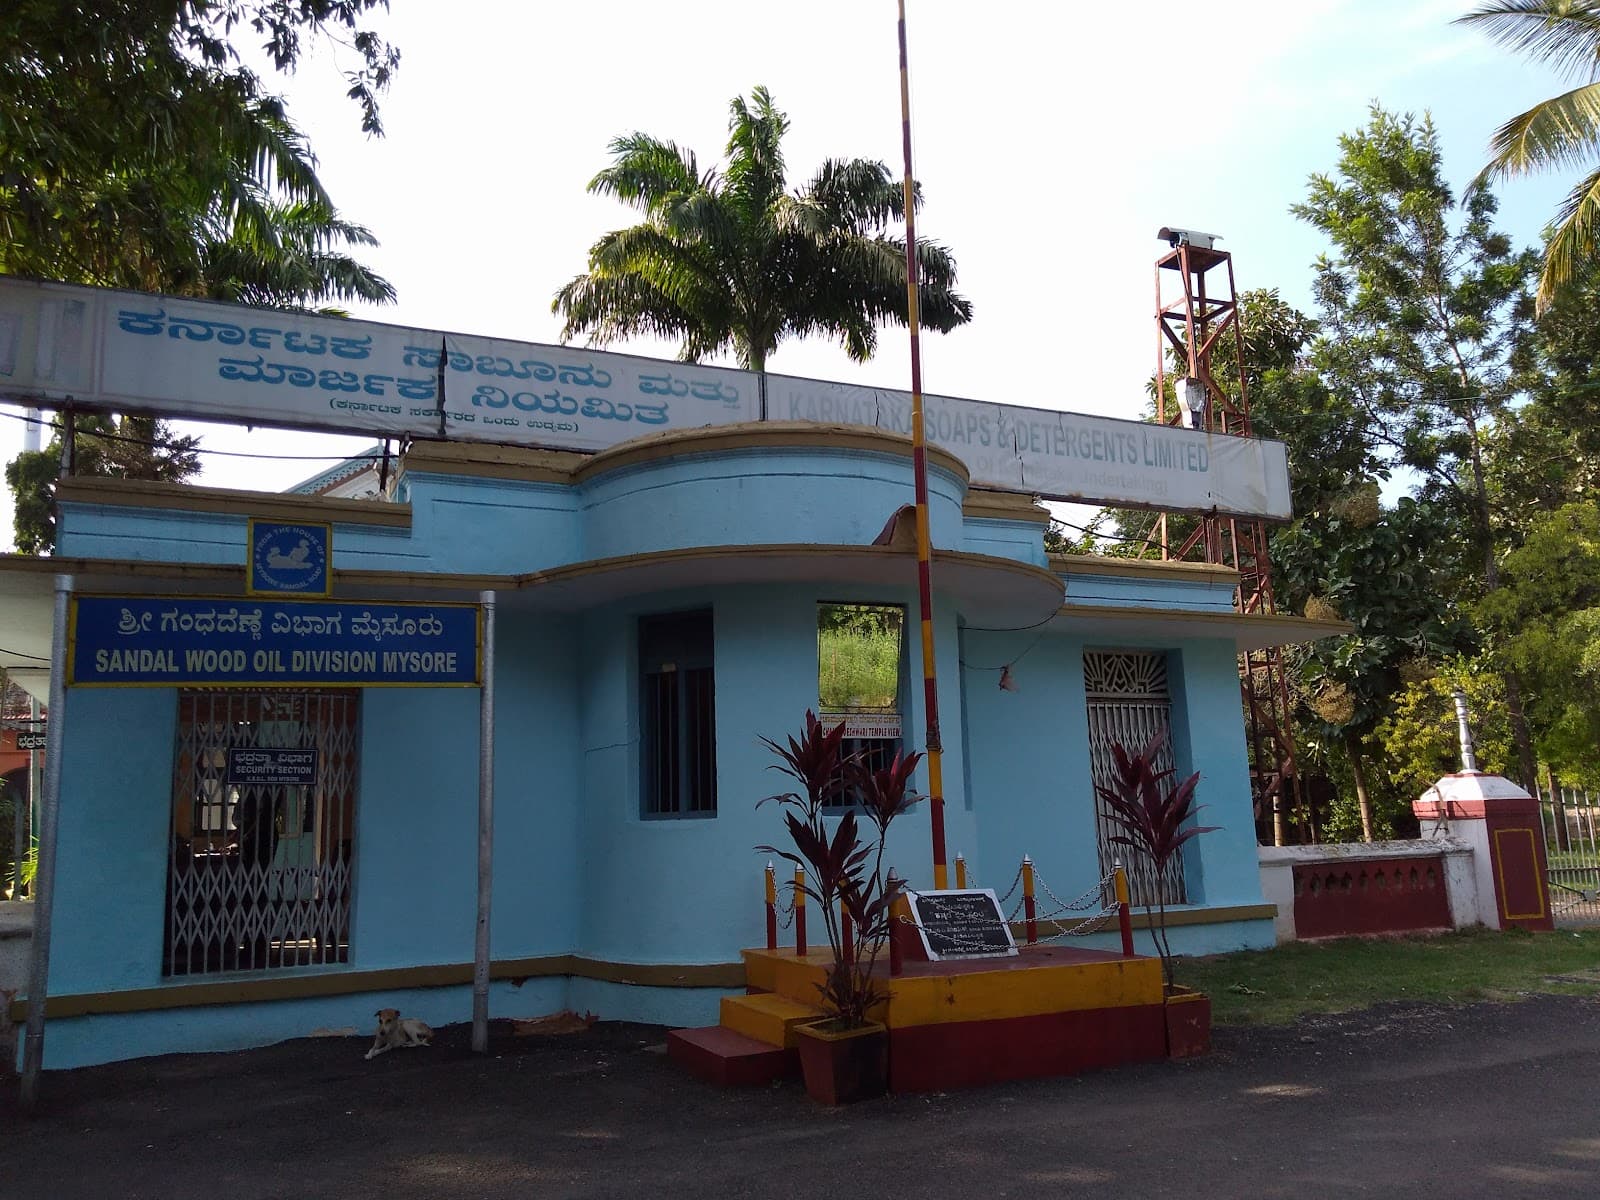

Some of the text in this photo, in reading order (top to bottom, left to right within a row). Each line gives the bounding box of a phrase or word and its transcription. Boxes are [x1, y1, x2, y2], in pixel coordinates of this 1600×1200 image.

[118, 308, 372, 360] ಕರ್ನಾಟಕ
[402, 345, 612, 388] ಸಾಬೂನು
[219, 355, 670, 425] ಮಾರ್ಜಕ ನಿಯಮಿತ
[329, 398, 402, 415] (ಕರ್ನಾಟಕ
[483, 416, 520, 427] ಒಂದು
[926, 407, 991, 447] SOAPS
[996, 413, 1012, 448] &
[1014, 420, 1137, 465] DETERGENTS
[1144, 433, 1209, 473] LIMITED
[117, 608, 443, 642] ಶ್ರೀ ಗಂಧದೆಣ್ಣೆ ವಿಭಾಗ ಮೈಸೂರು
[95, 649, 457, 673] SANDAL WOOD OIL DIVISION MYSORE
[869, 727, 887, 737] TEMPLE
[888, 727, 901, 737] VIEW
[235, 765, 312, 774] SECURITY SECTION
